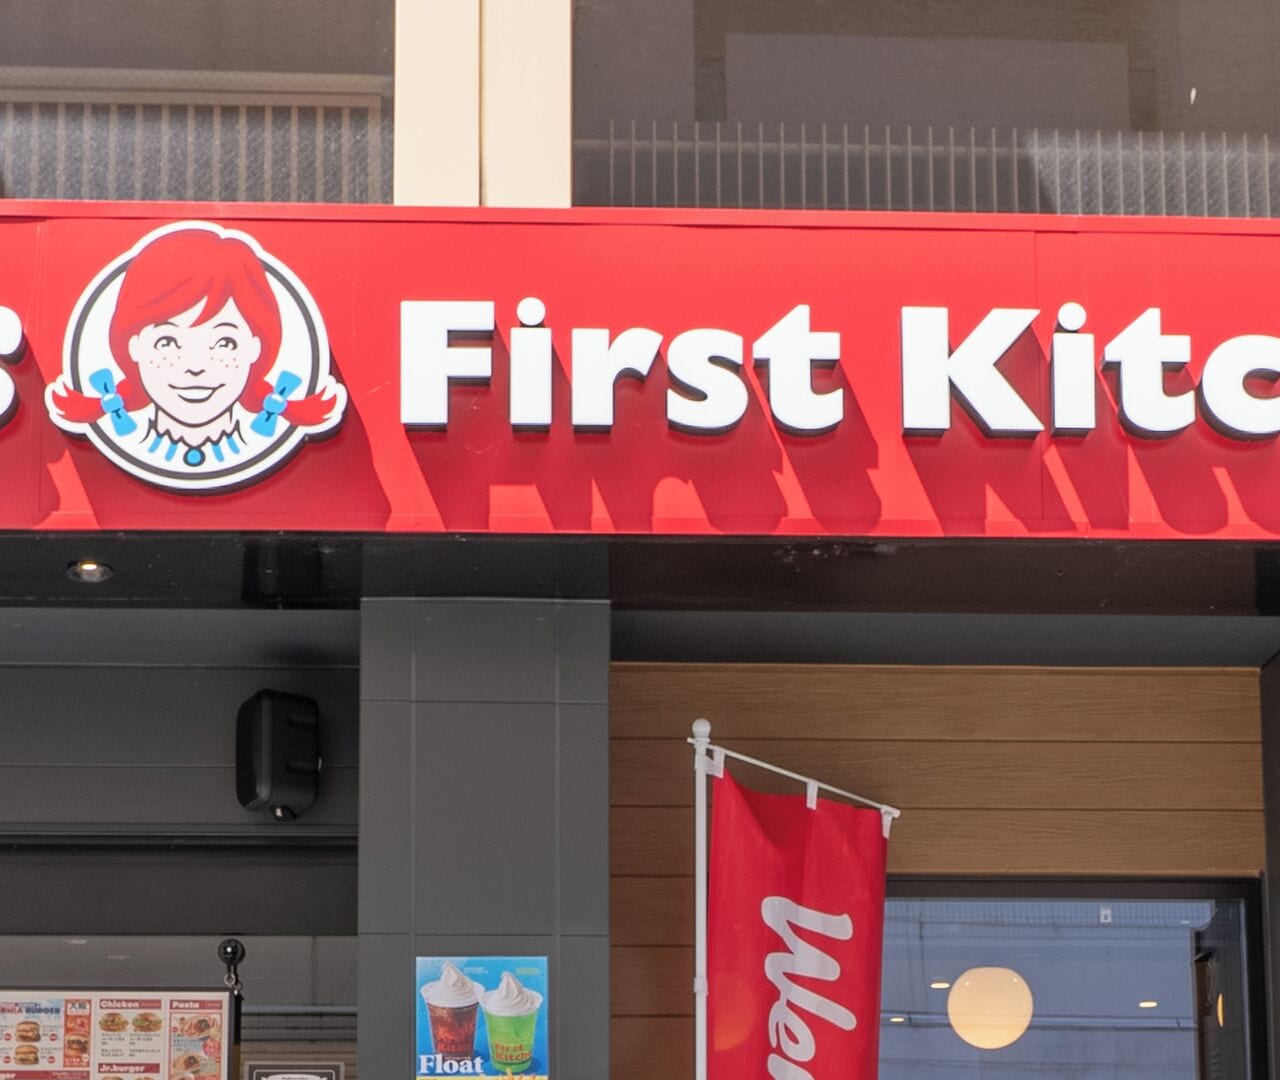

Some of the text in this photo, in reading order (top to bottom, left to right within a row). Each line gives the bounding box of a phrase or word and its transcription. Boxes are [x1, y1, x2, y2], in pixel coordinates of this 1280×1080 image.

[400, 297, 842, 433] First
[100, 1000, 140, 1009] Chicken
[172, 1001, 200, 1009] Pasta
[99, 1064, 145, 1074] Jr.burger
[418, 1053, 485, 1075] Float
